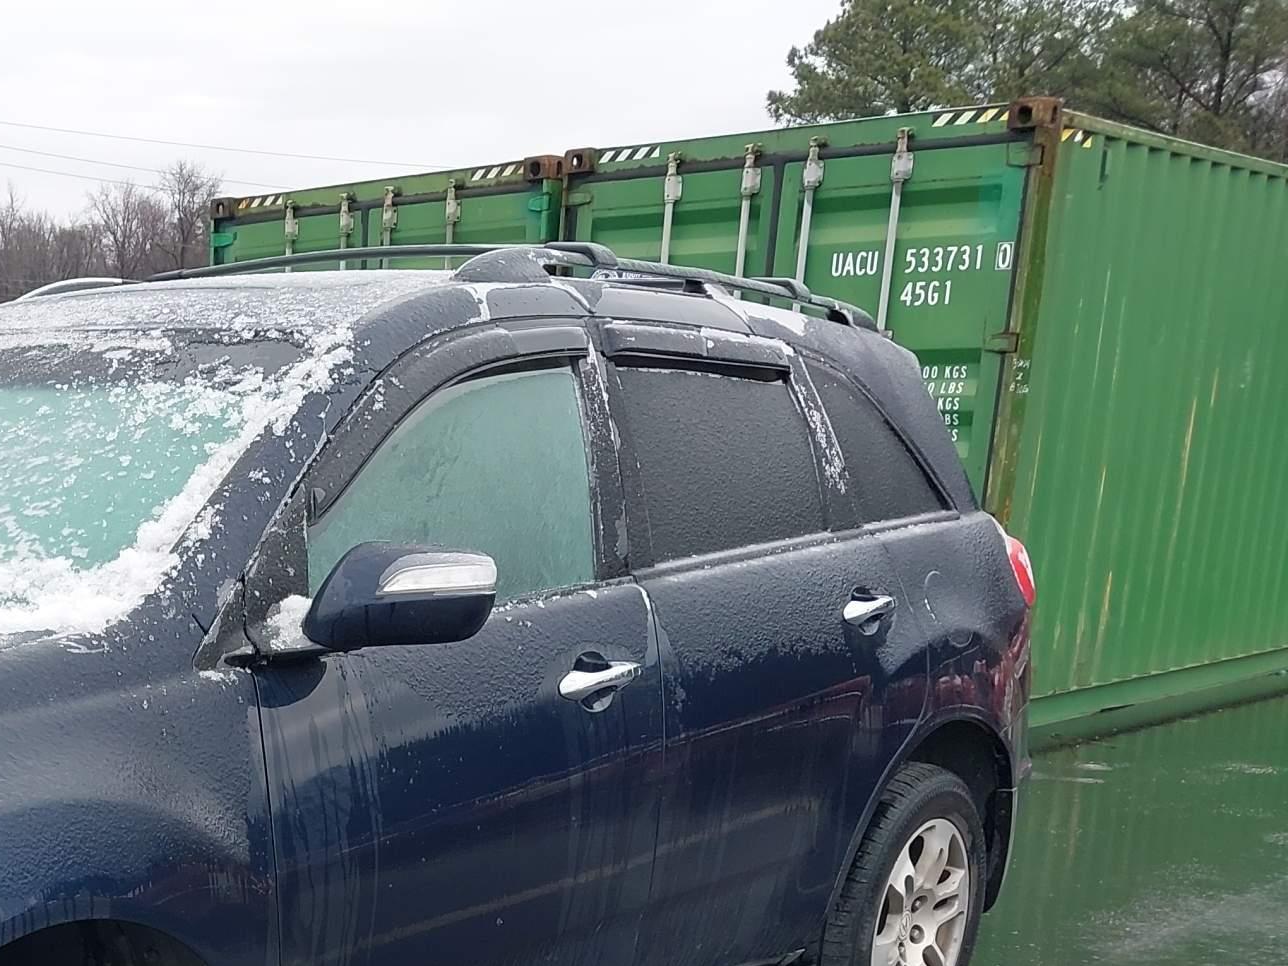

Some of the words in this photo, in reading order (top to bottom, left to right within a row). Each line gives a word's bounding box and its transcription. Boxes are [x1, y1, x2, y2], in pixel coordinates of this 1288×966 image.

[831, 251, 879, 277] UACU
[904, 244, 984, 273] 533731
[900, 280, 952, 306] 45G1
[922, 366, 938, 379] 00
[944, 365, 967, 379] KGS
[940, 381, 964, 394] LBS
[937, 397, 960, 411] KGS
[944, 413, 959, 426] BS
